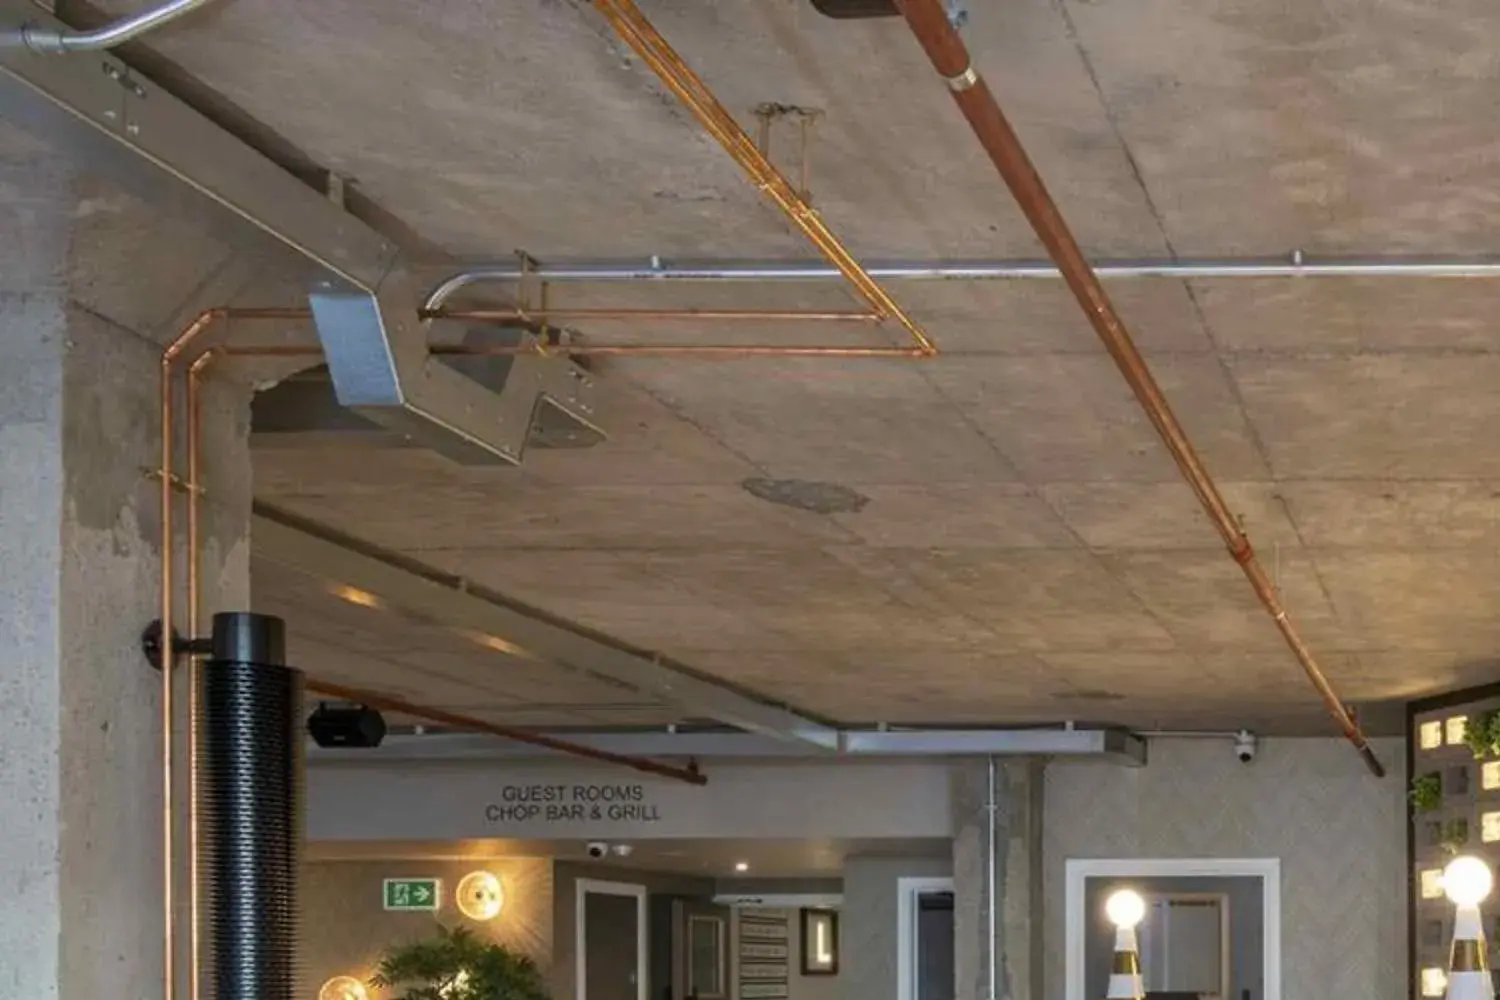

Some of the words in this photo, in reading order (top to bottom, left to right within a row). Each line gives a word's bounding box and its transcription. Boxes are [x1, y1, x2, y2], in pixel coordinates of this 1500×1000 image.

[502, 785, 567, 801] GUEST
[573, 785, 643, 801] ROOMS
[485, 805, 540, 821] CHOP
[546, 805, 586, 821] BAR
[590, 805, 602, 820] &
[607, 804, 661, 821] GRILL
